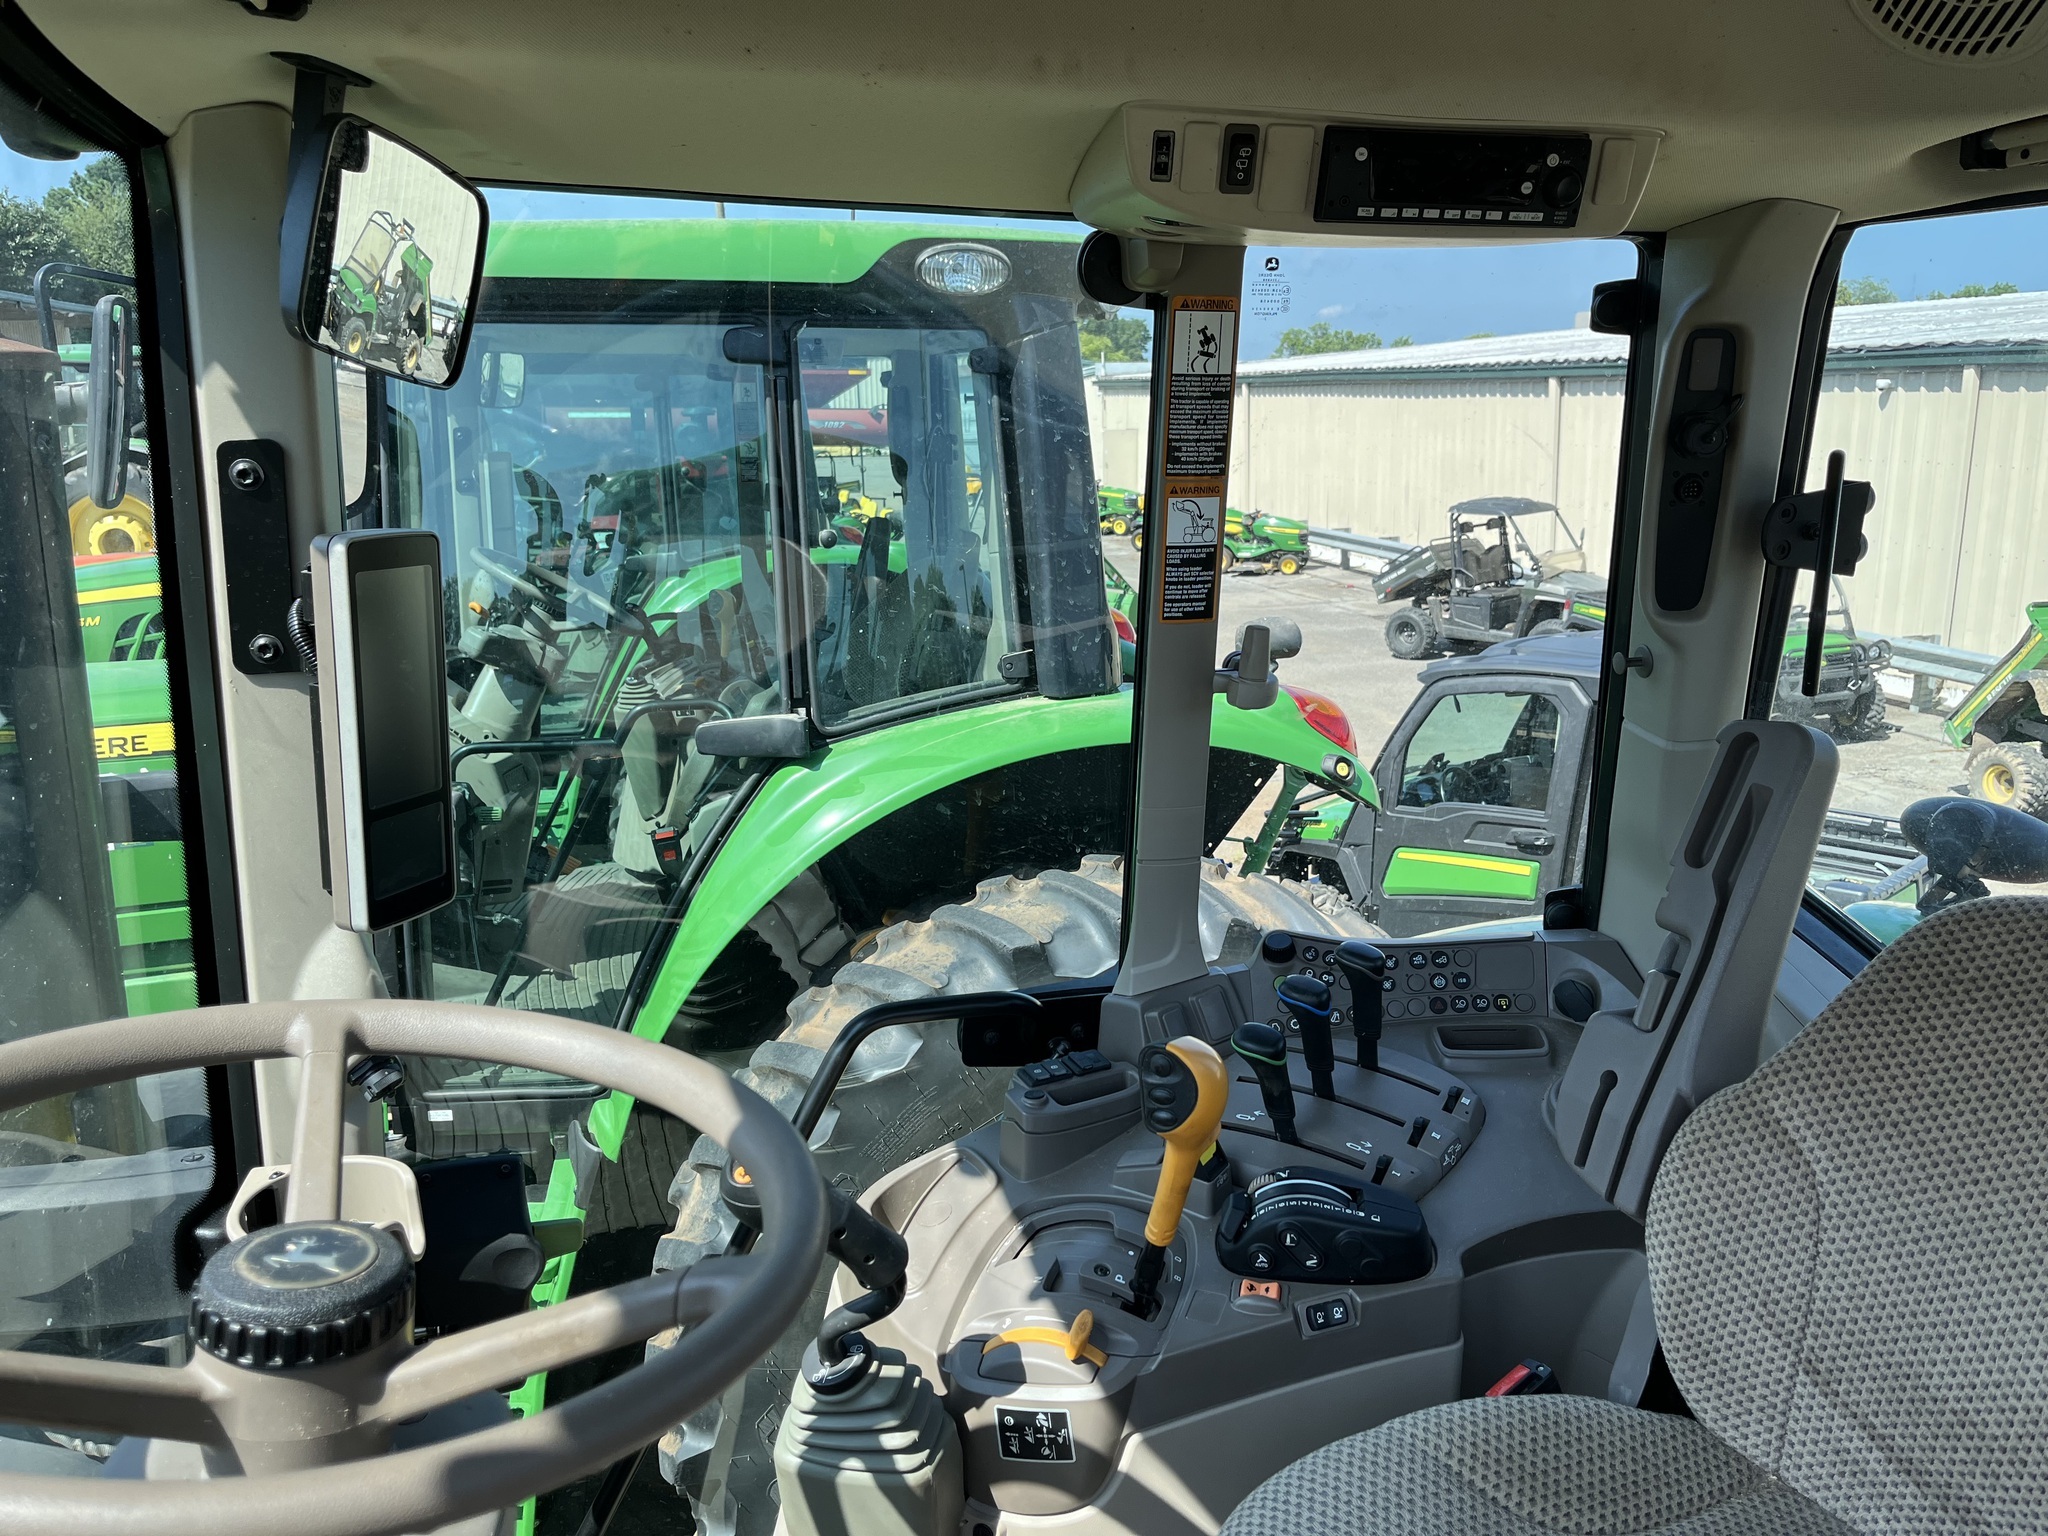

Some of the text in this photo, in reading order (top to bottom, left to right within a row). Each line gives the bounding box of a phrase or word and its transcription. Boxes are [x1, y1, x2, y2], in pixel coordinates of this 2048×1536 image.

[1190, 298, 1234, 310] WARNING
[1180, 486, 1220, 494] WARNING
[1114, 1274, 1126, 1284] P
